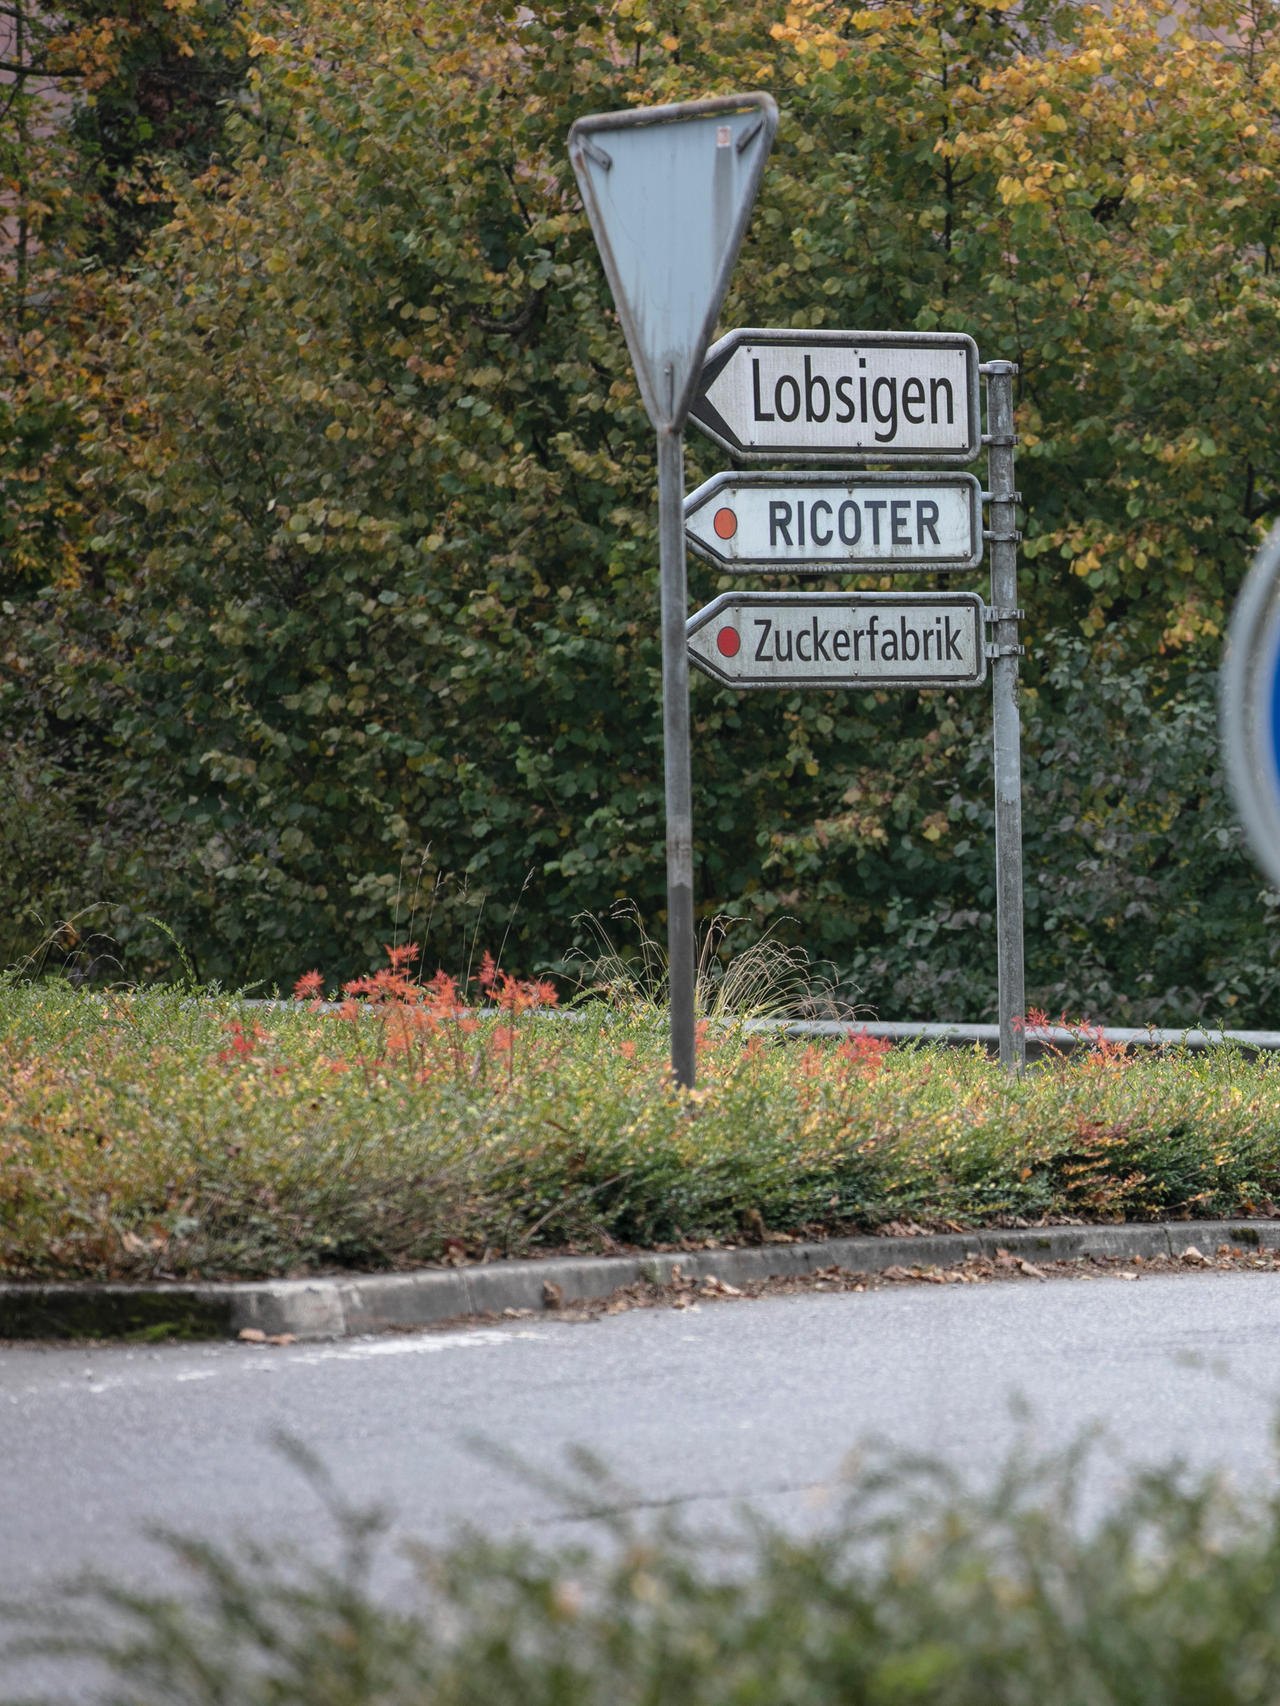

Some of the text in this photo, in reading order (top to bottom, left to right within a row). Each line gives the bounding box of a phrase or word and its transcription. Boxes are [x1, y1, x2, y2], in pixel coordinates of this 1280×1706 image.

[752, 355, 954, 442] Lobsigen
[769, 500, 941, 547] RICOTER
[753, 616, 963, 663] Zuckerfabrik
